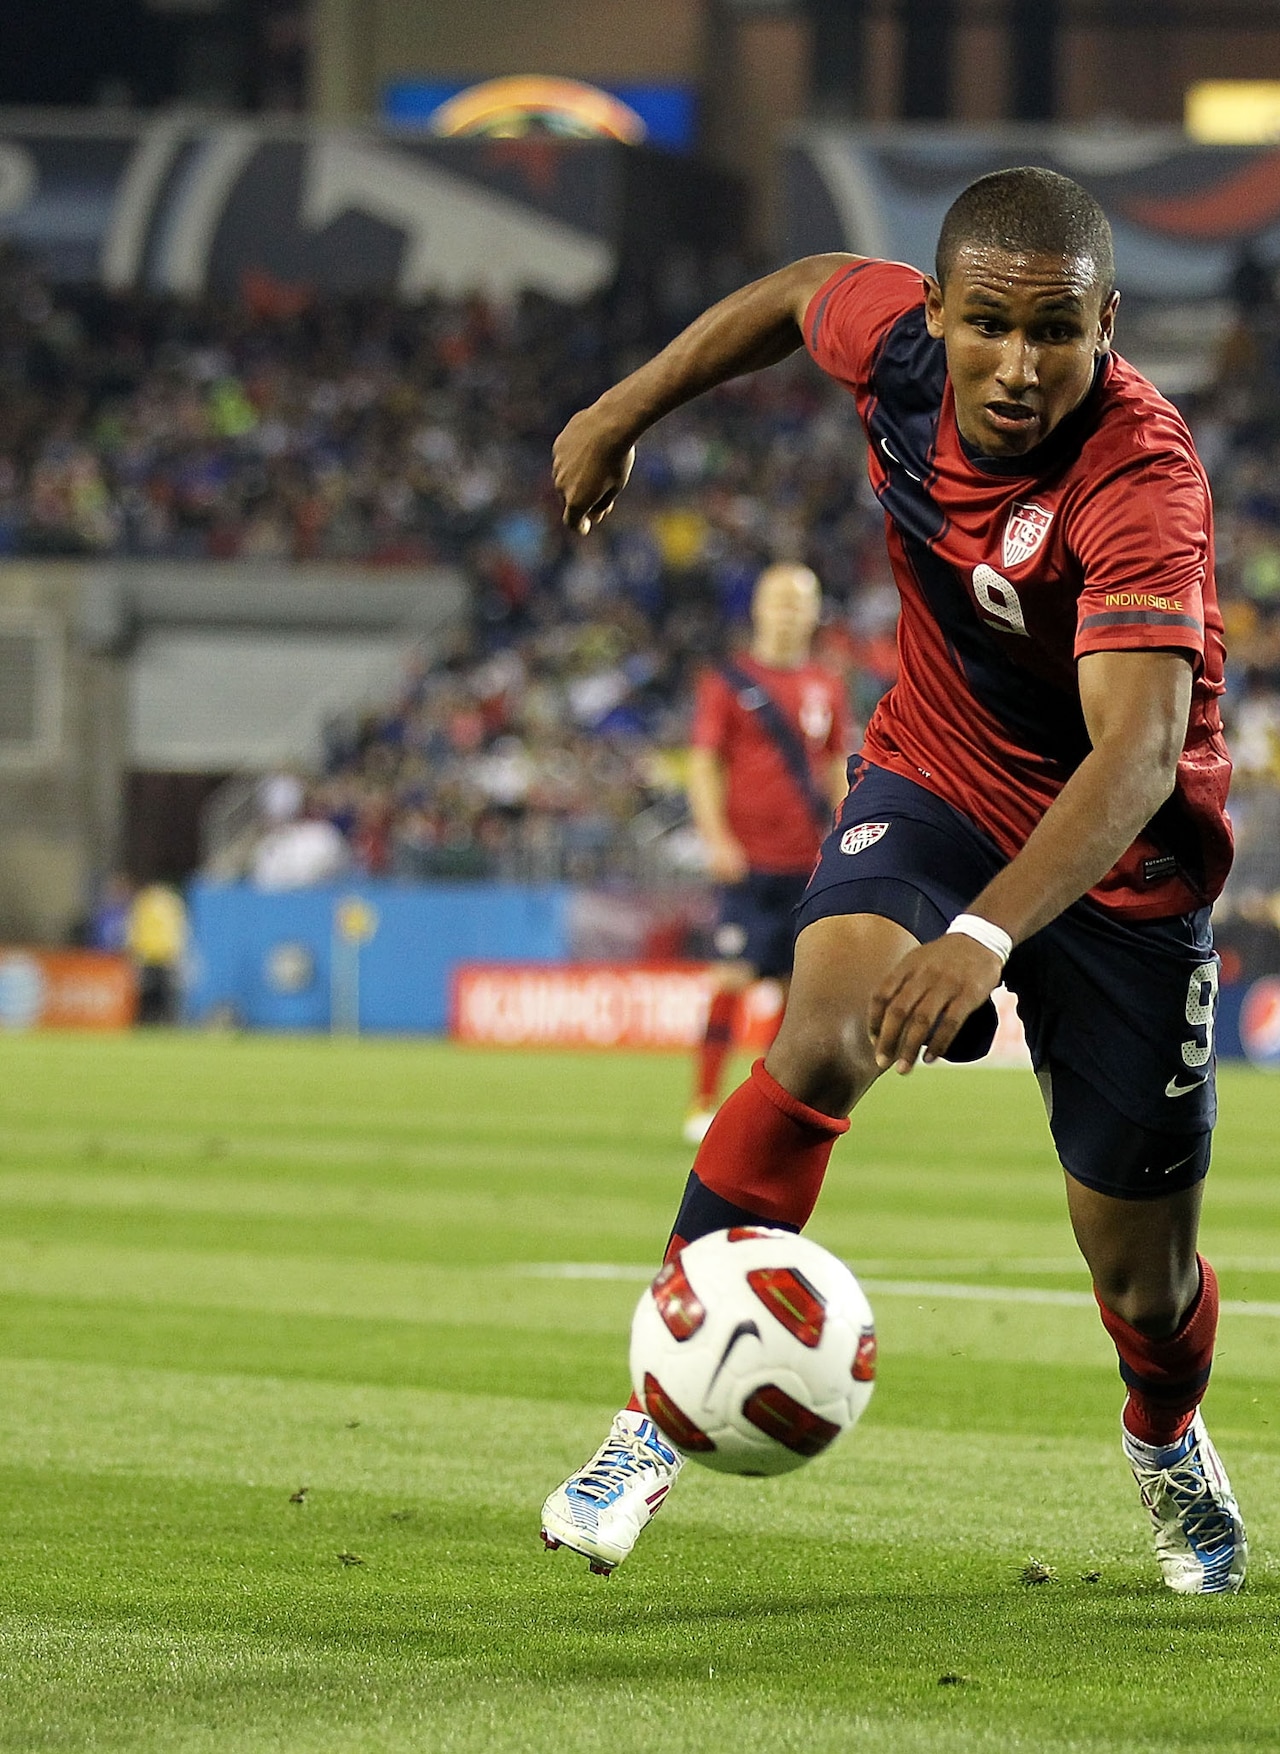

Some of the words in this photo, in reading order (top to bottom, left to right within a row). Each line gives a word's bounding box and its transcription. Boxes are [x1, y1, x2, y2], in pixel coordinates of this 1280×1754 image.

[972, 563, 1030, 637] 9
[1105, 593, 1185, 611] INDIVISIBLE
[1181, 961, 1219, 1067] 9
